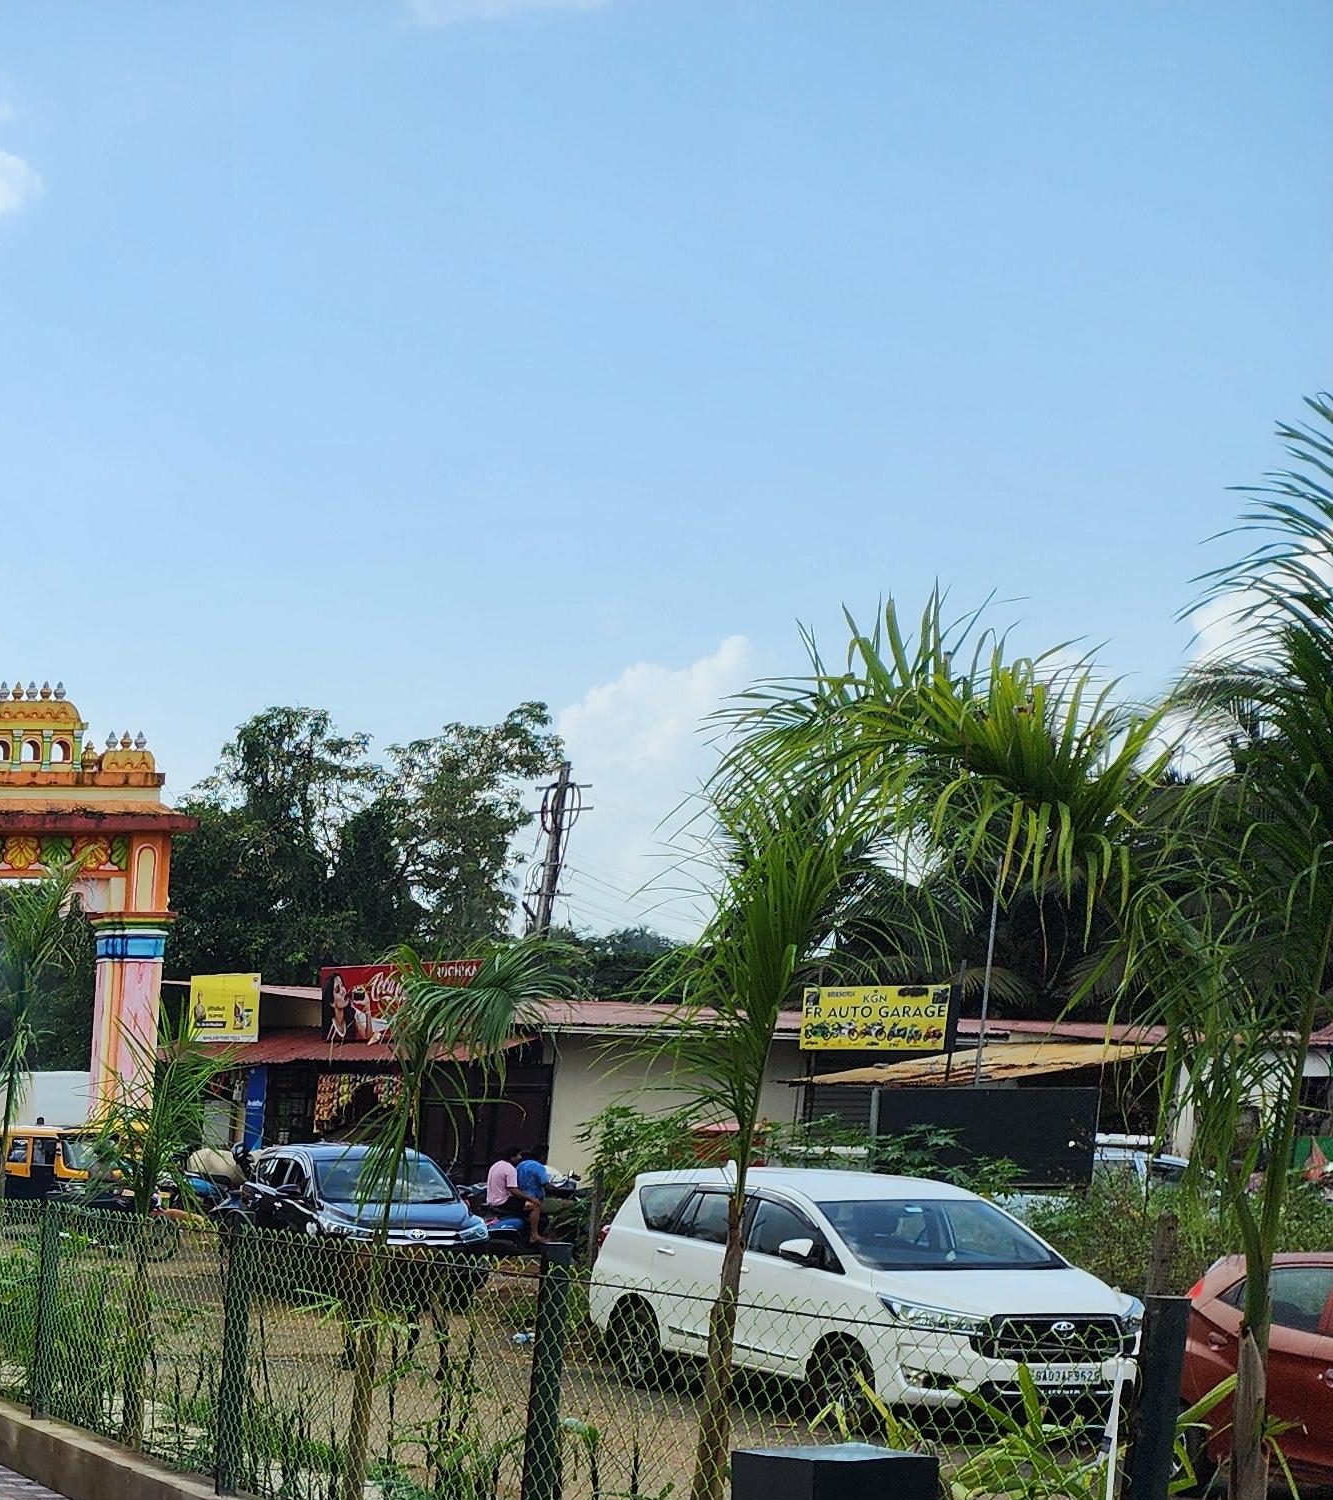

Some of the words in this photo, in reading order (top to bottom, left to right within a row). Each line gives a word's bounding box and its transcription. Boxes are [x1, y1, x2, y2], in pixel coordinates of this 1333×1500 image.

[863, 994, 888, 1003] KGN
[805, 1006, 822, 1018] FR
[827, 1005, 873, 1018] AUTO
[878, 1004, 946, 1018] GARAGE
